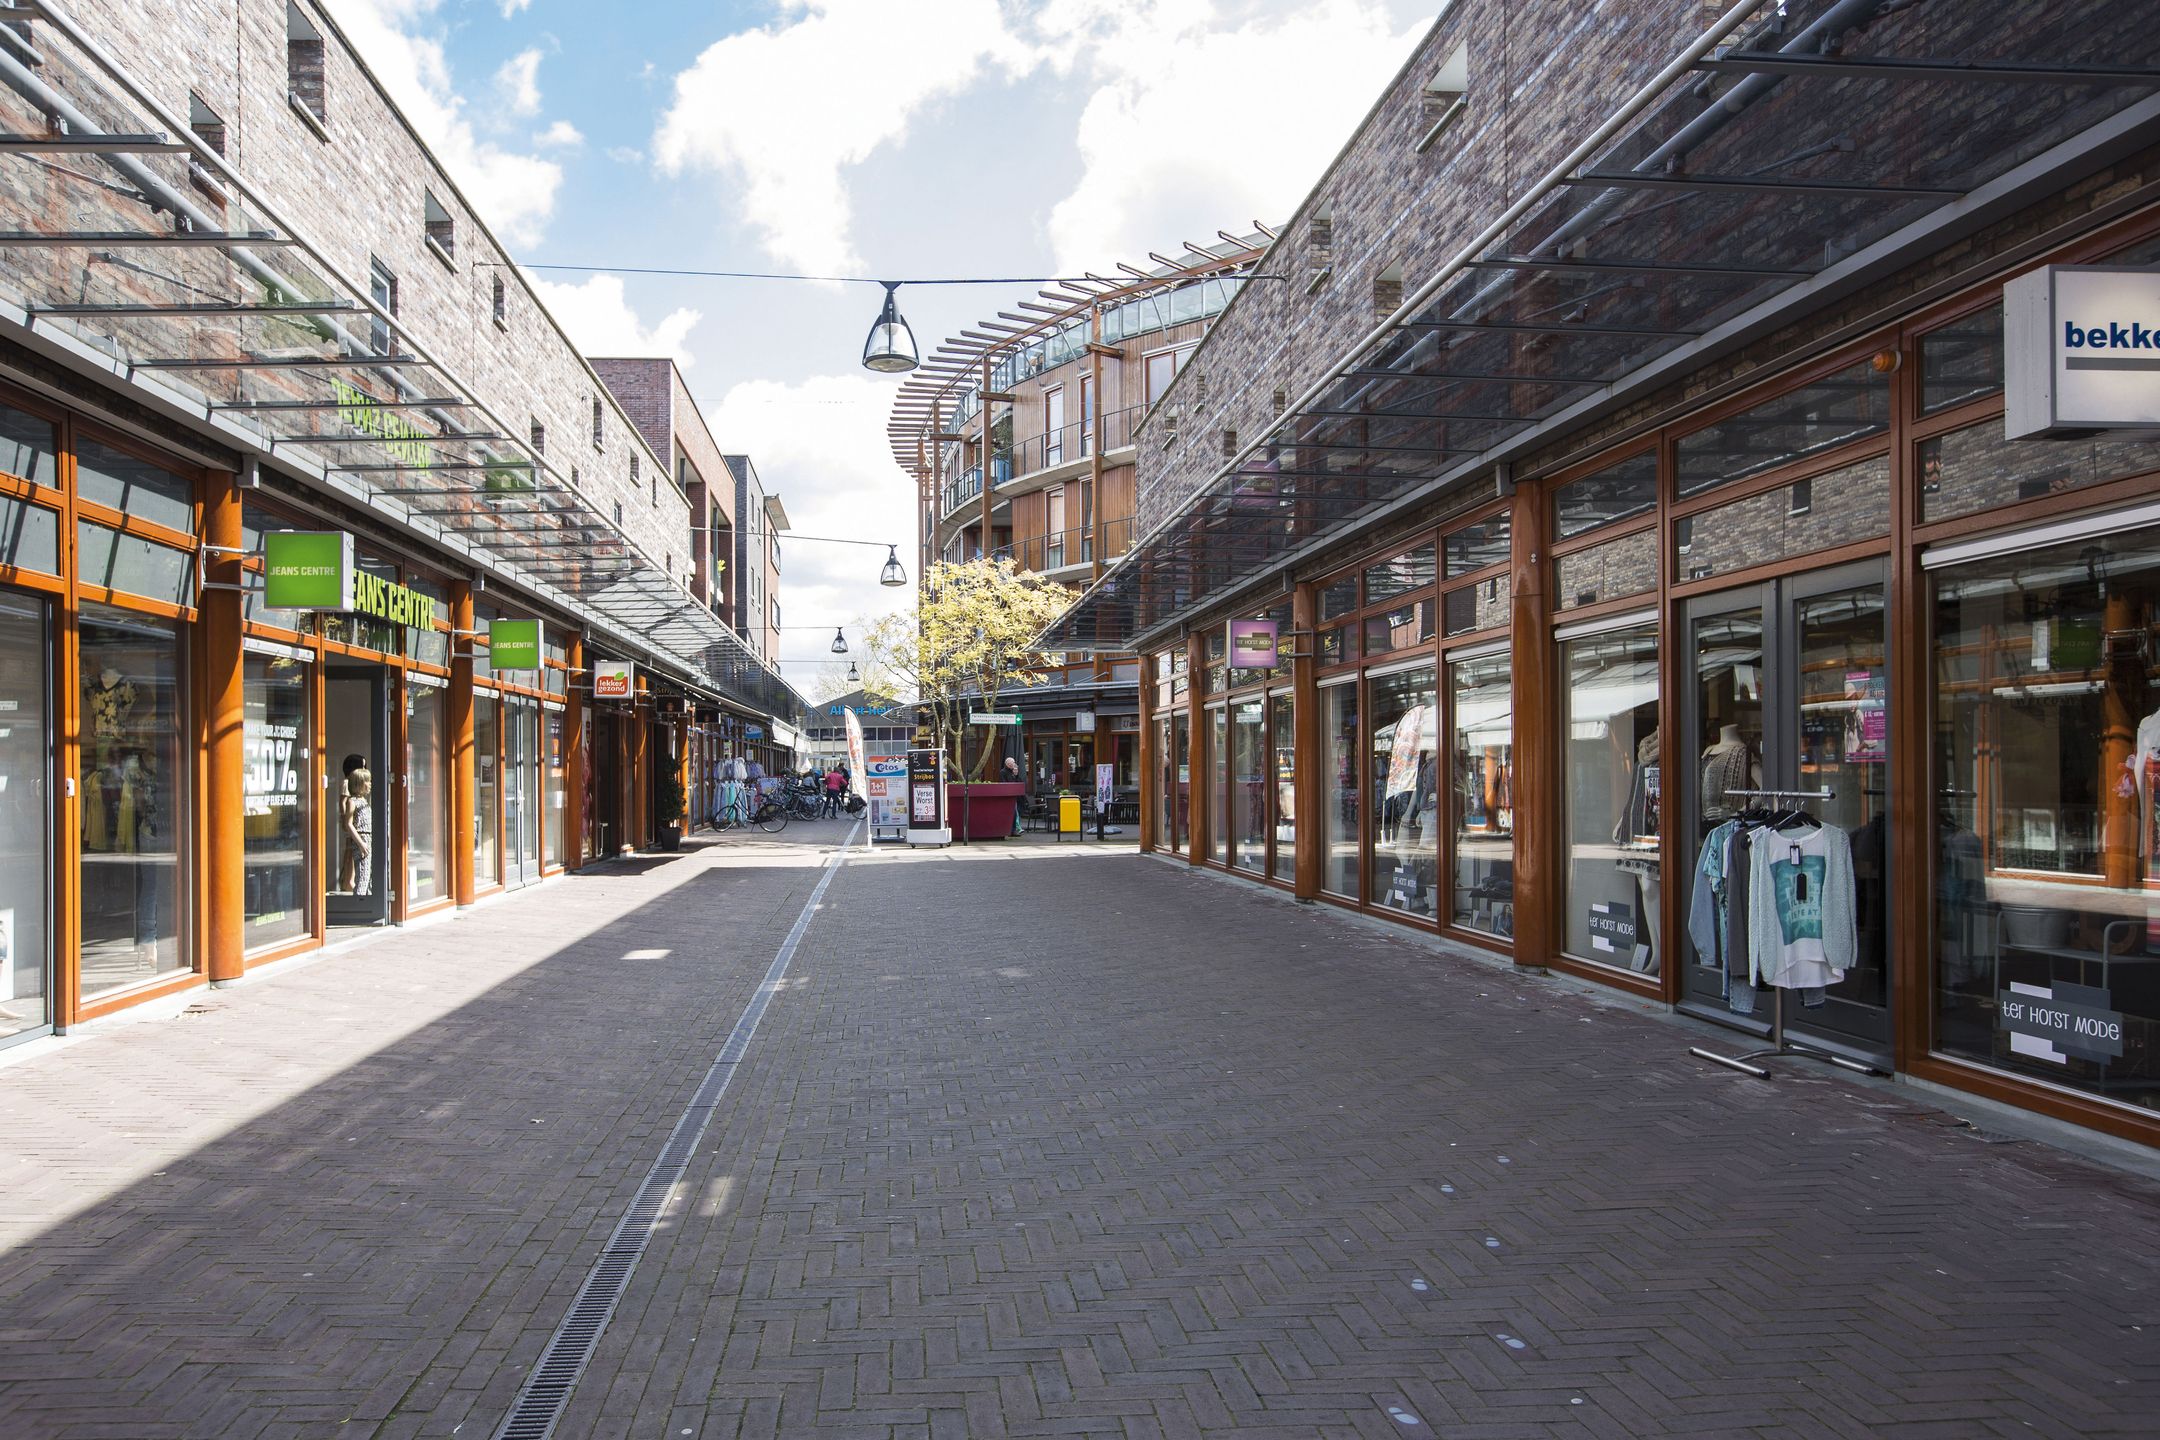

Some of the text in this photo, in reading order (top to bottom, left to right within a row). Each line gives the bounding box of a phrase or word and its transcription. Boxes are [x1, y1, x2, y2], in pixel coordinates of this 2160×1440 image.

[270, 566, 335, 576] JEANS CENTRE
[353, 568, 436, 632] ANS CENTRE
[512, 641, 534, 649] CENTRE
[599, 679, 623, 687] lekker
[598, 685, 625, 693] gezond
[829, 703, 864, 716] Alrt
[871, 782, 885, 790] 1+1
[2002, 1001, 2025, 1020] ter
